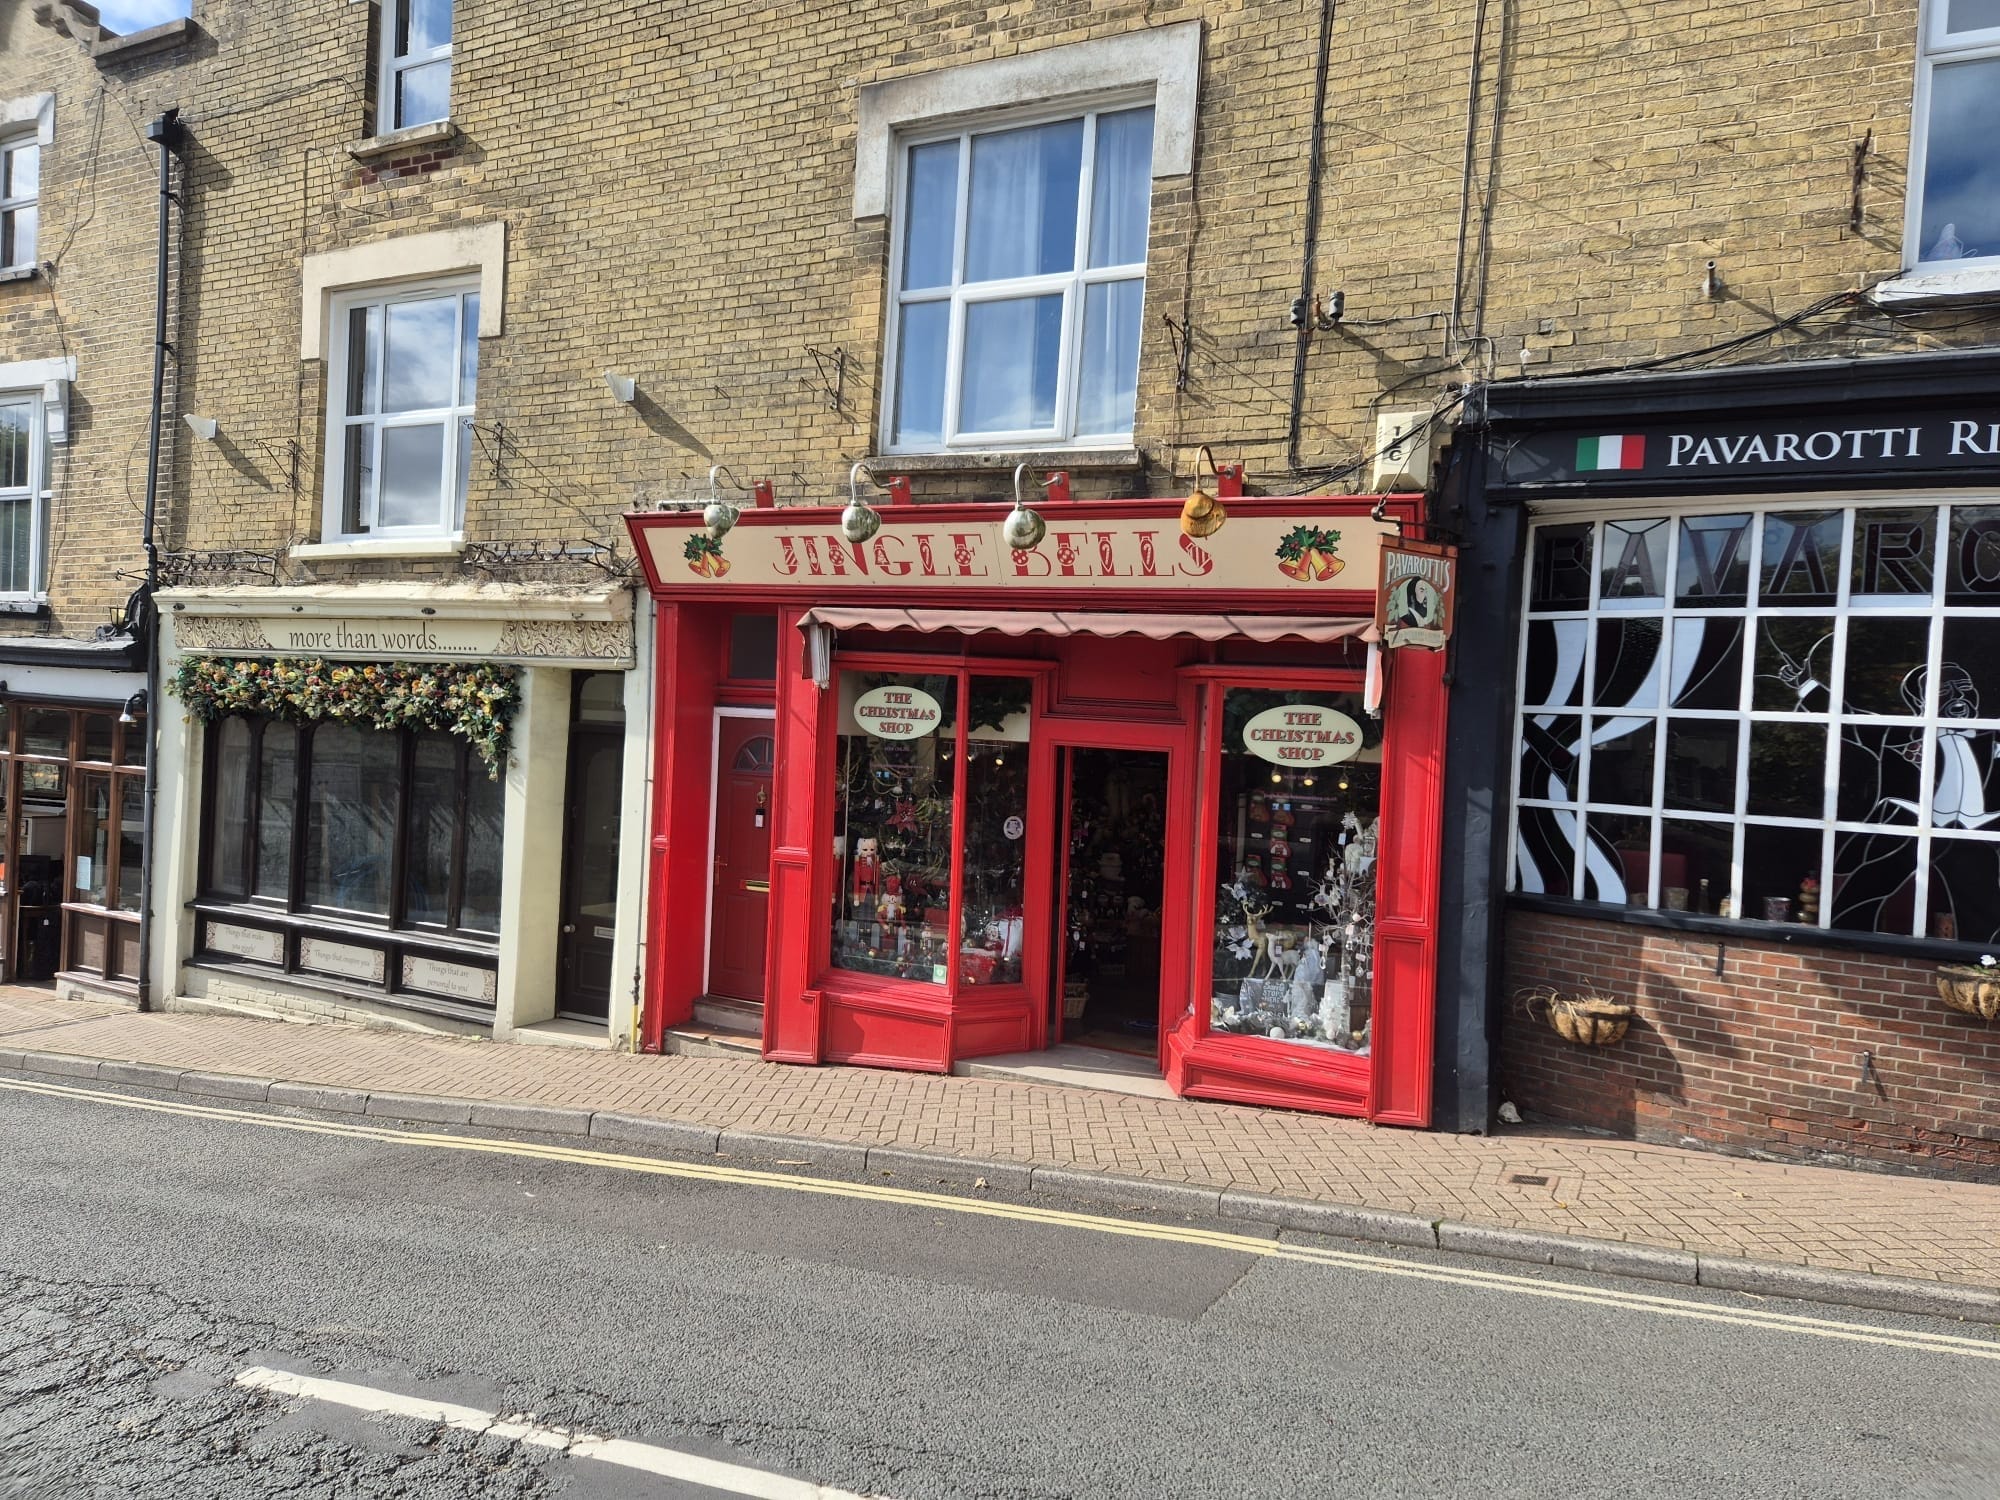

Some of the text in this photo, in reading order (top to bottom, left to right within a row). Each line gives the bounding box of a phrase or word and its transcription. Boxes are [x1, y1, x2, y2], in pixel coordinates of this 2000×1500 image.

[1666, 427, 1923, 467] PAVAROTTI
[773, 531, 1214, 577] JINGLE BELLS
[1384, 551, 1450, 593] PAVAROTTI'S
[289, 631, 331, 649] more
[336, 620, 378, 649] than
[884, 692, 912, 704] THE
[860, 706, 936, 721] CHRISTMAS
[1283, 712, 1322, 726] THE
[879, 722, 914, 735] SHOP
[1250, 729, 1355, 745] CHRISTMAS
[1277, 747, 1325, 761] SHOP
